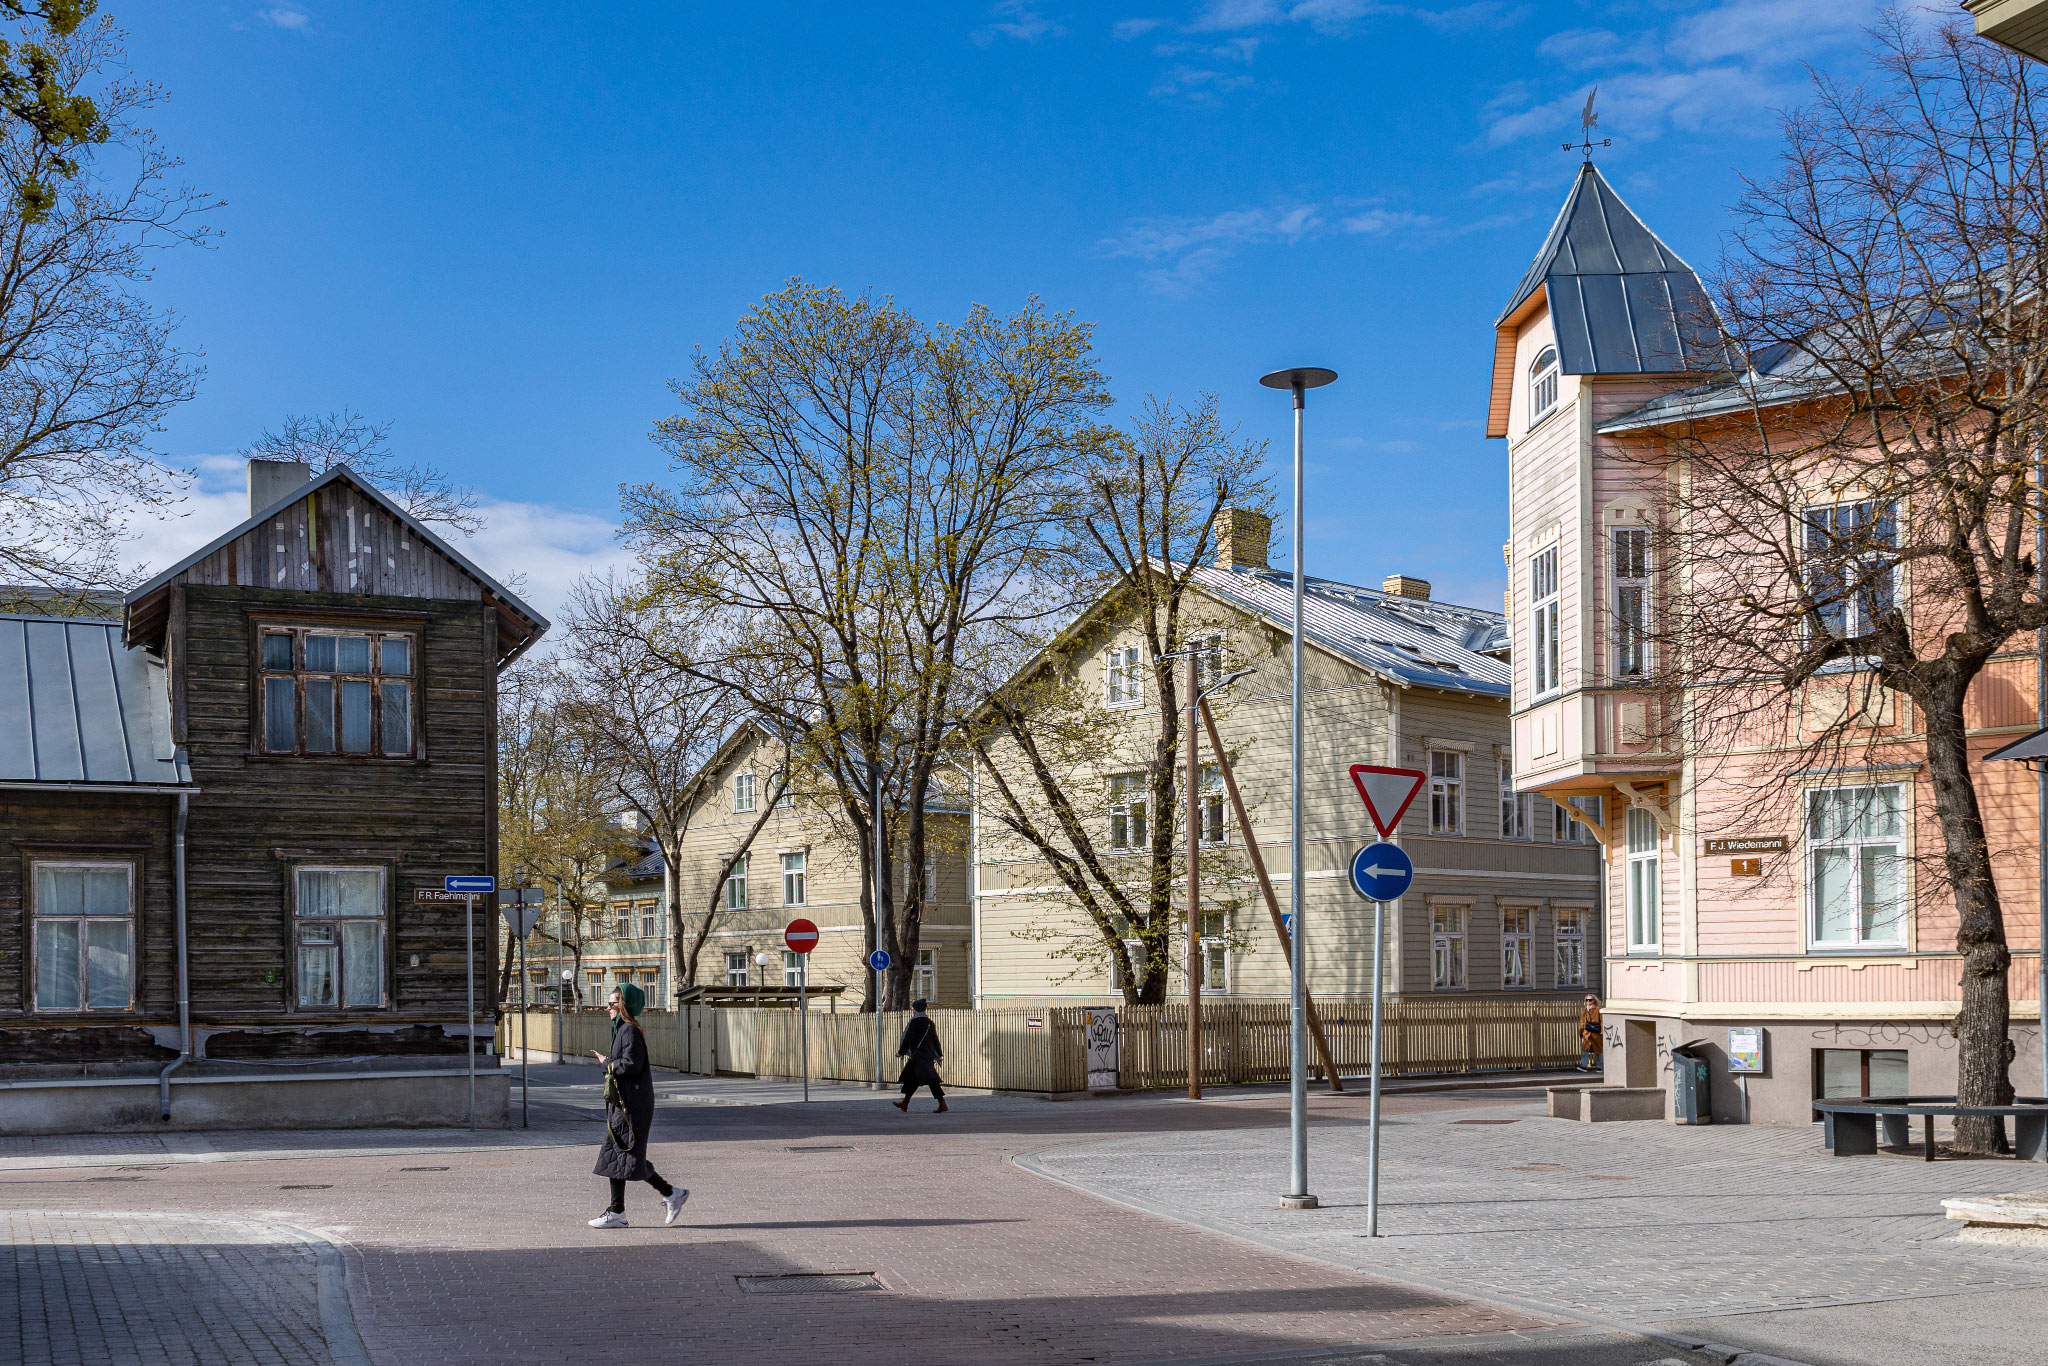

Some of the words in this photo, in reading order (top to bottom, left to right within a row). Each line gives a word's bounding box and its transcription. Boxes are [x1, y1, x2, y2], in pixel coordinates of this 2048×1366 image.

[1562, 143, 1572, 152] W
[1603, 138, 1612, 147] E
[1727, 839, 1782, 850] Wiedemanni
[1741, 860, 1748, 872] 1
